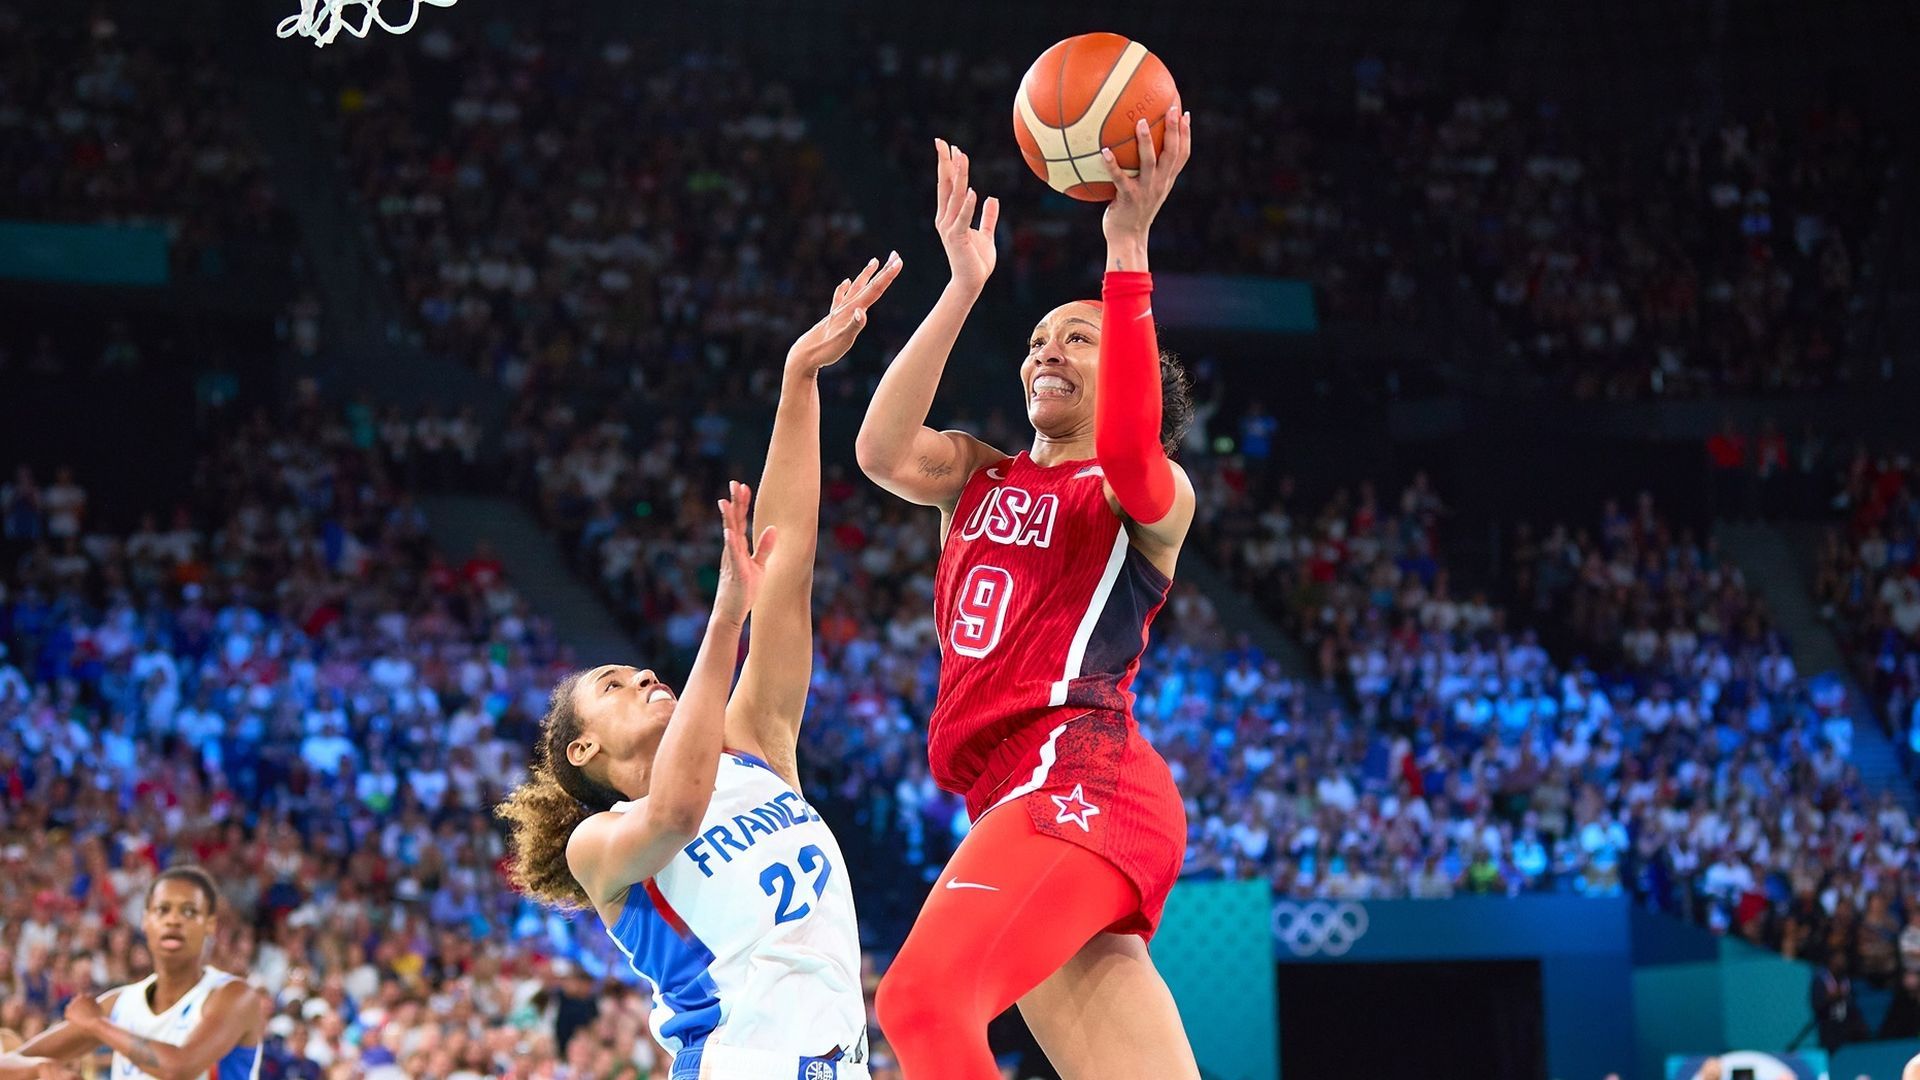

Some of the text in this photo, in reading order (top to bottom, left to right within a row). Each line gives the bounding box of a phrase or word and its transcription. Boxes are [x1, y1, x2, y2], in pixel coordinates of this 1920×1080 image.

[1126, 80, 1166, 121] PARIS
[963, 487, 1059, 548] USA
[951, 565, 1014, 659] 9
[759, 844, 832, 926] 22
